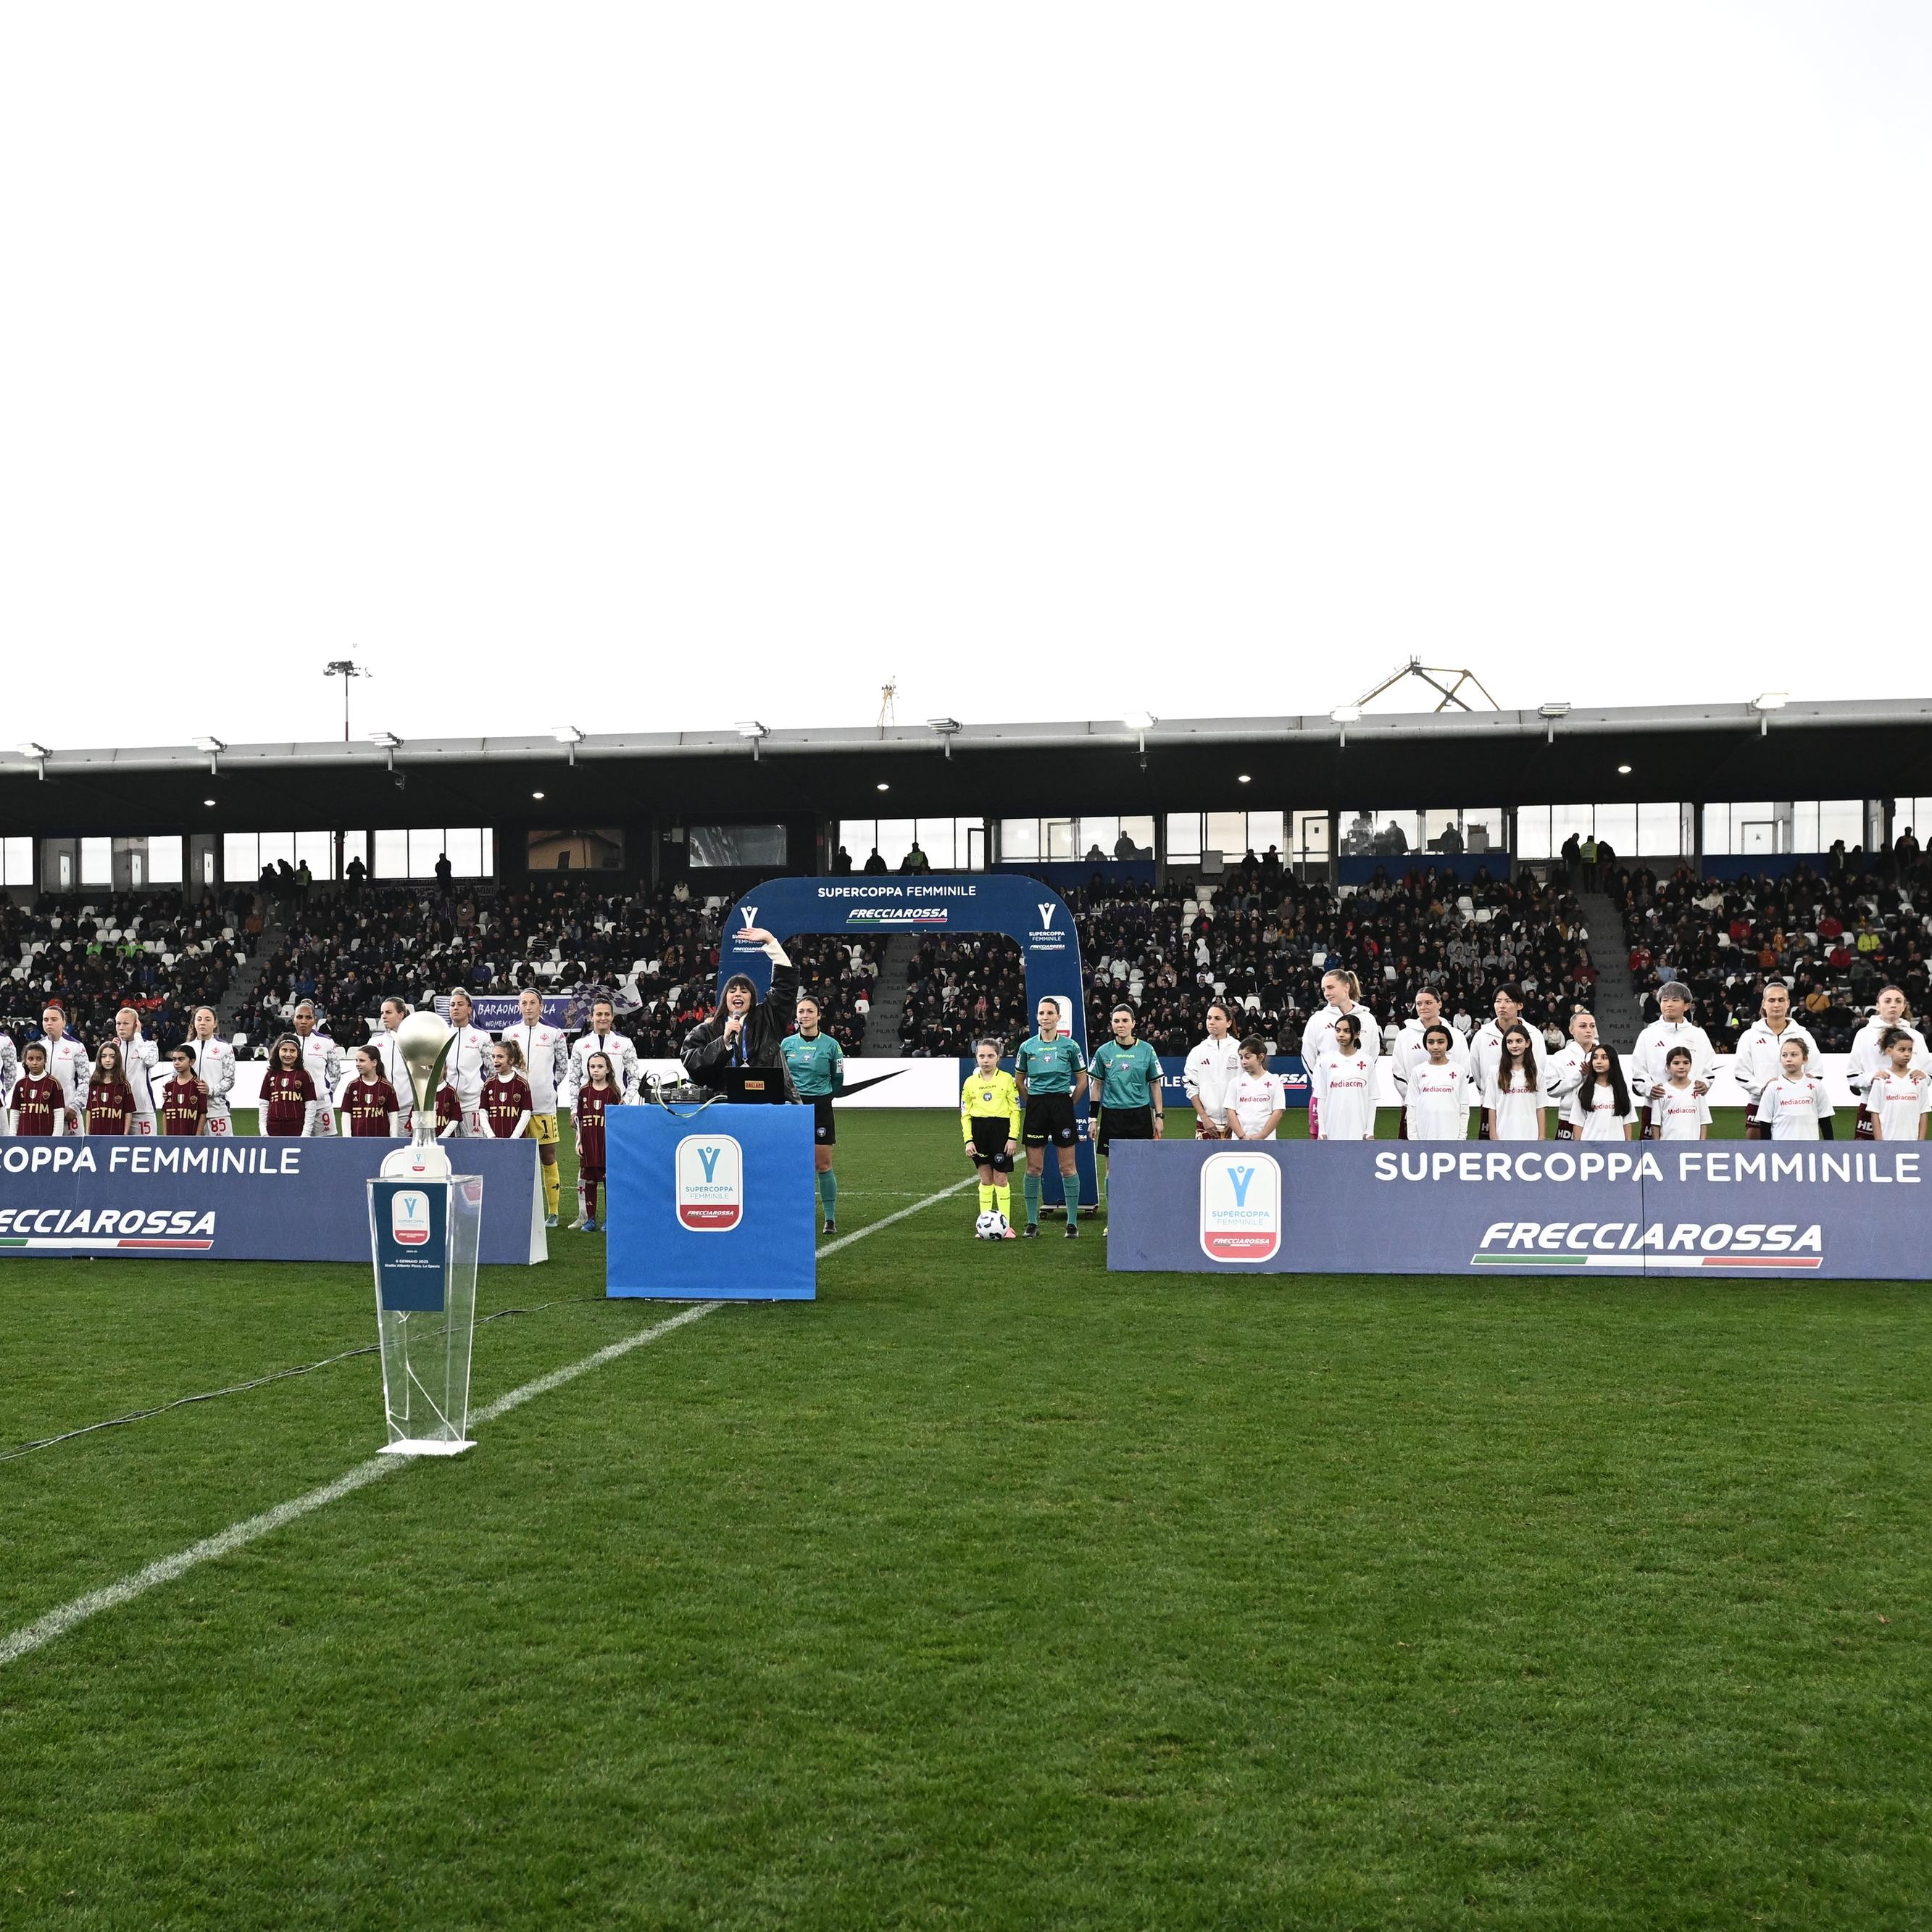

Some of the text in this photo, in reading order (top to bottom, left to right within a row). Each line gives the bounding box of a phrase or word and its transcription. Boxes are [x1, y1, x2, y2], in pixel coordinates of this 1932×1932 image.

[817, 886, 976, 898] SUPERCOPPA FEMMINILE
[849, 908, 948, 918] FRECCIAROSSA
[1330, 1080, 1363, 1088] Mediacom
[280, 1091, 303, 1102] TIM
[1779, 1097, 1811, 1107] Mediacom
[28, 1103, 49, 1114] TIM
[99, 1107, 122, 1120] TIM
[177, 1108, 198, 1120] TIM
[363, 1107, 384, 1117] TIM
[321, 1112, 330, 1126] 9
[138, 1121, 151, 1135] 15
[210, 1118, 227, 1133] 85
[541, 1119, 548, 1133] 1
[0, 1146, 301, 1174] OPPA FEMMINILE
[1375, 1152, 1922, 1183] SUPERCOPPA FEMMINILE
[1479, 1221, 1823, 1252] FRECCIAROSSA
